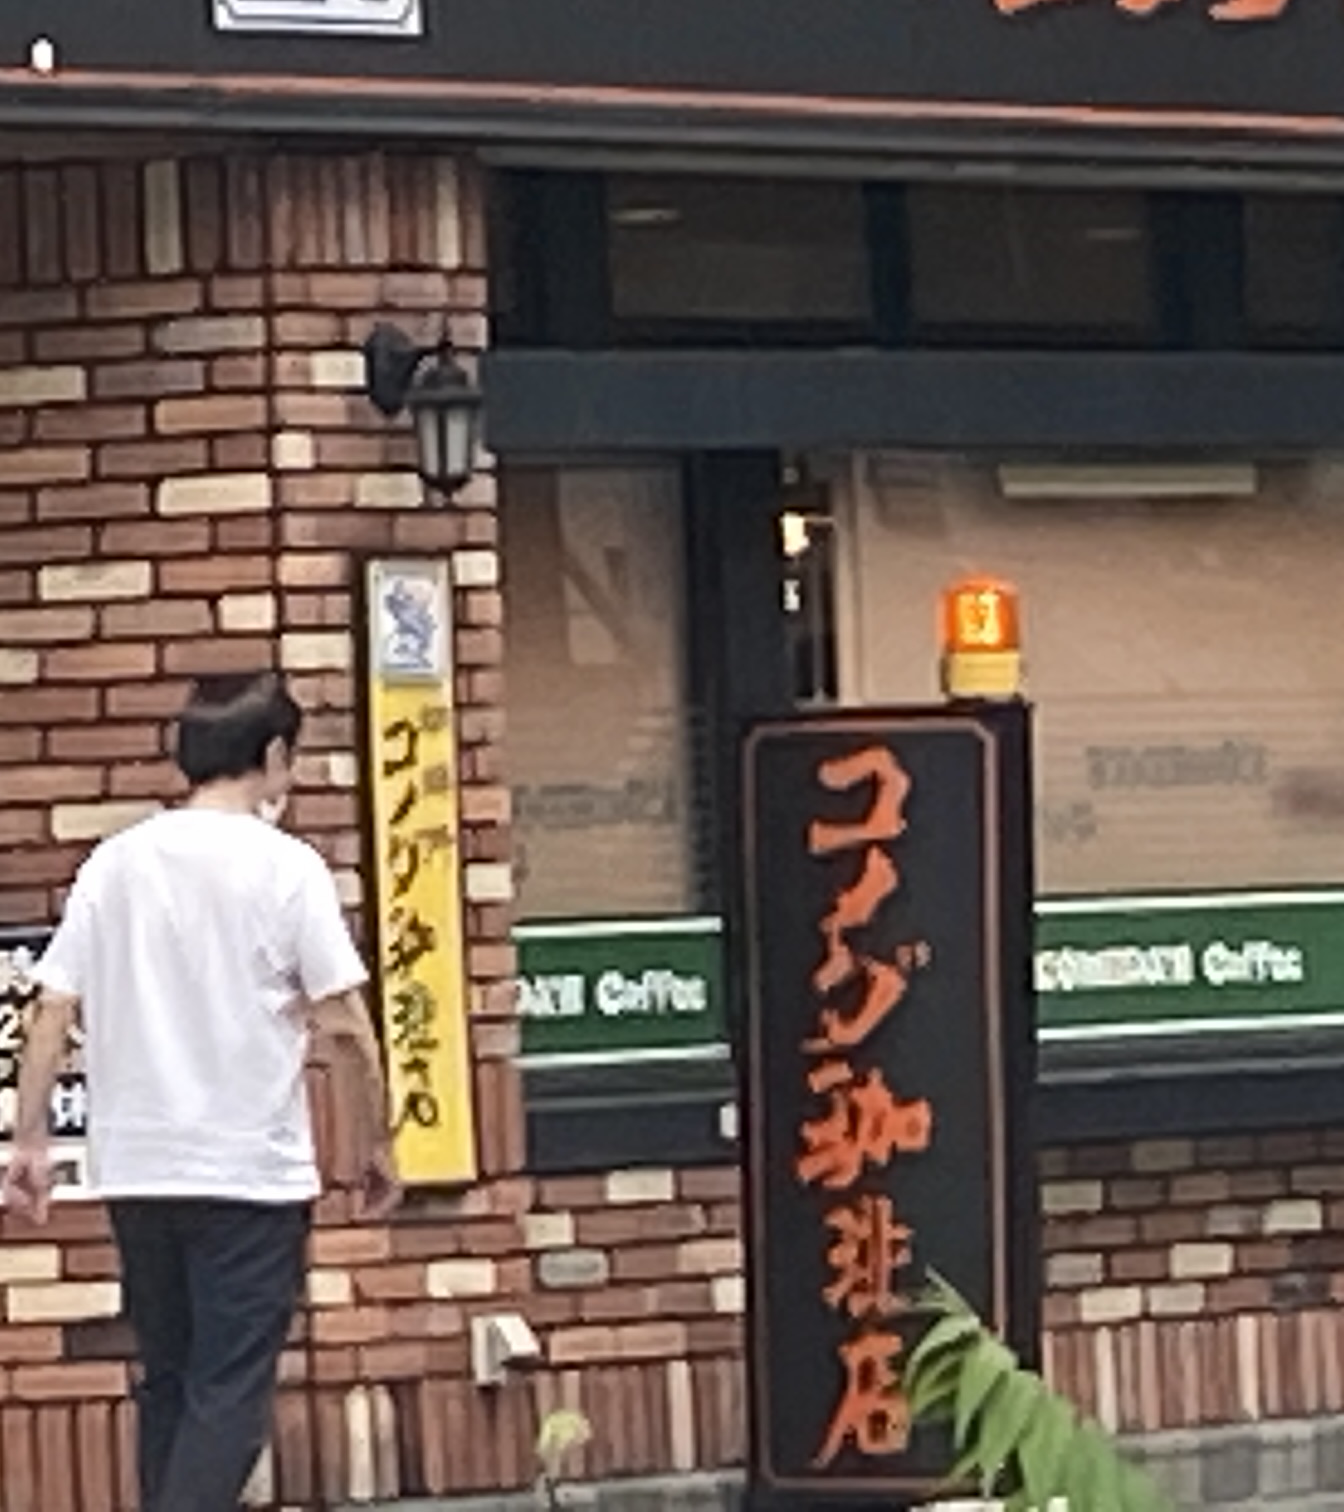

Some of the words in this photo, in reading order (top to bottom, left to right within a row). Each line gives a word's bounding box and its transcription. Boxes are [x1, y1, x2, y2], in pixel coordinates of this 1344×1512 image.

[797, 745, 933, 1471] コメダ珈琲店
